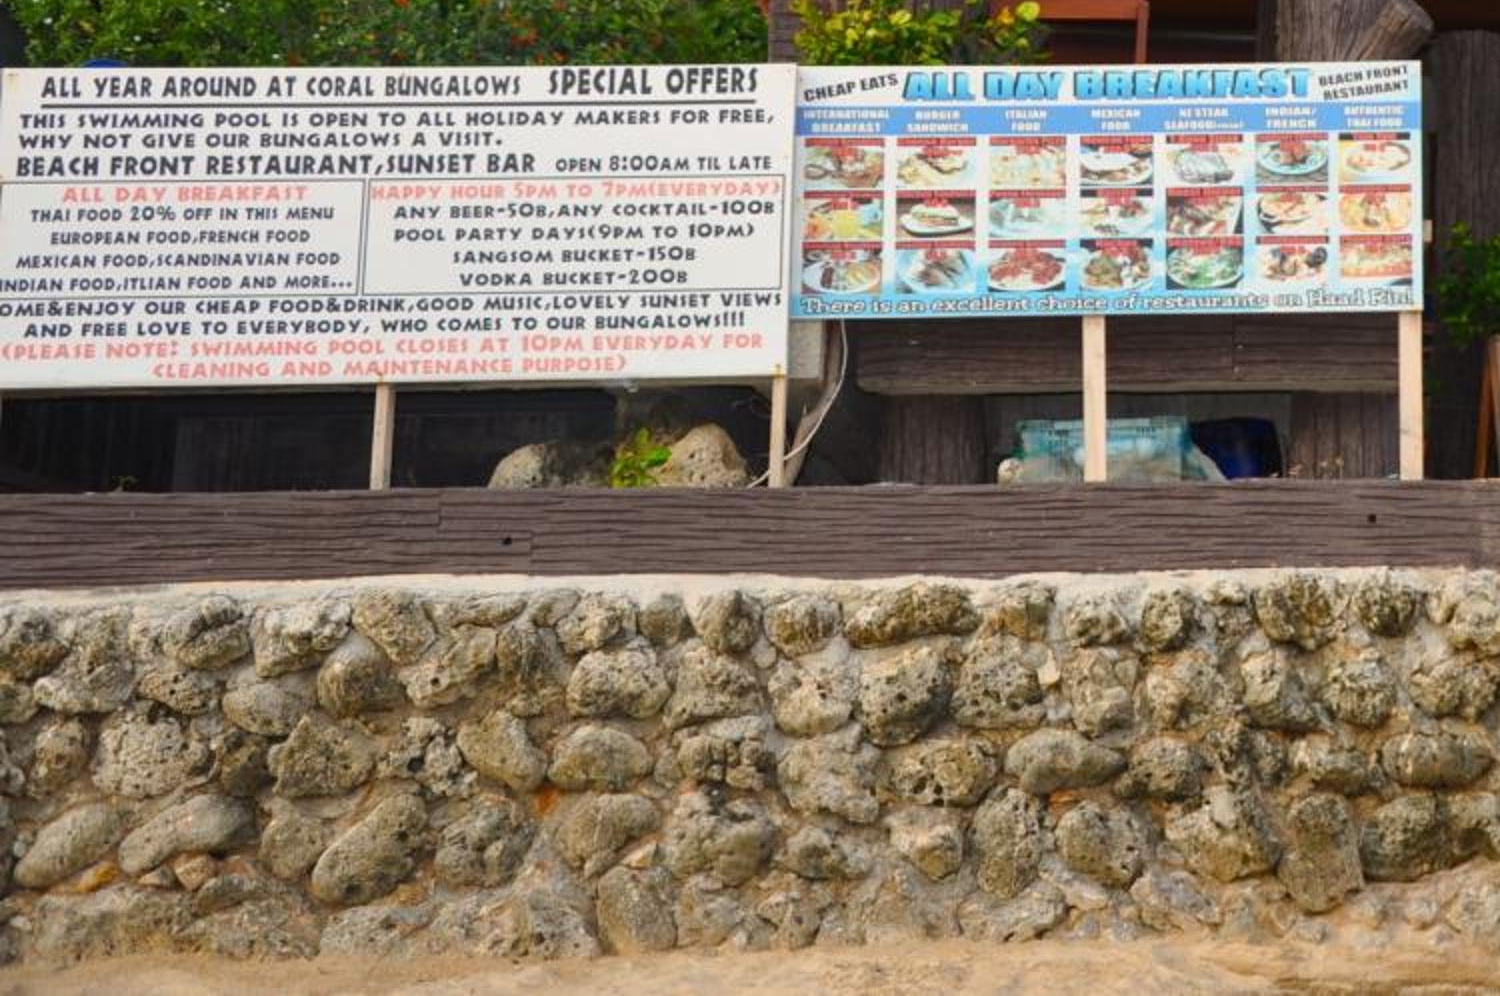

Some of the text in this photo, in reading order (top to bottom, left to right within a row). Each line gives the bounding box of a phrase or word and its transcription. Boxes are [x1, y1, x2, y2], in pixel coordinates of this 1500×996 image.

[41, 67, 757, 98] ALL YEAR AROUND AT CORAL BUNGALOWS SPECIAL OFFERS
[902, 68, 1312, 101] ALL DAY BREAKFAST
[1318, 65, 1407, 87] BEACH FRONT
[803, 74, 898, 102] CHEAP EATS
[1323, 80, 1409, 100] RESTAURANT
[20, 109, 773, 128] THIS SWIMMING POOL IS OPEN TO ALL HOLIDAY MAKERS FOR FREE,
[19, 132, 502, 149] WHY NOT GIVE OUR BUNGALOWS A VISIT.
[16, 153, 771, 176] BEACH FRONT RESTAURANT,SUNSET BAR OPEN 8:00AM TIL LATE
[62, 185, 307, 203] ALL DAY BREAKFAST
[377, 179, 780, 200] HAPPY HOUR 5PM TO 7PM(EVERYDAY)
[32, 206, 334, 222] THAI FOOD 20% OFF IN THIS MENU
[394, 200, 774, 219] ANY BEER-50B,ANY COCKTAIL-100B
[51, 230, 310, 245] EUROPEAN FOOD,FRENCH FOOD
[394, 223, 754, 241] POOL PARTY DAYS(9PM TO 10PM)
[16, 252, 340, 268] MEXICAN FOOD,SCANDINAVIAN FOOD
[454, 246, 695, 264] SANGSOM BUCKET-150B
[0, 275, 352, 292] INDIAN FOOD,ITLIAN FOOD AND MORE...
[460, 269, 687, 286] VODKA BUCKET-200B
[145, 293, 781, 314] OUR CHEAP FOOD&DRINK,GOOD MUSIC,LOVELY SUNSET VIEWS
[803, 295, 865, 314] There
[925, 295, 1027, 312] excellent
[1036, 294, 1108, 312] choice
[24, 311, 744, 337] AND FREE LOVE TO EVERYBODY, WHO COMES TO OUR BUNGALOWS!!!
[2, 334, 763, 361] (PLEASE NOTE: SWIMMING POOL CLOSES AT 10PM EVERYDAY FOR
[153, 356, 627, 379] CLEANING AND MAINTENANCE PURPOSE)
